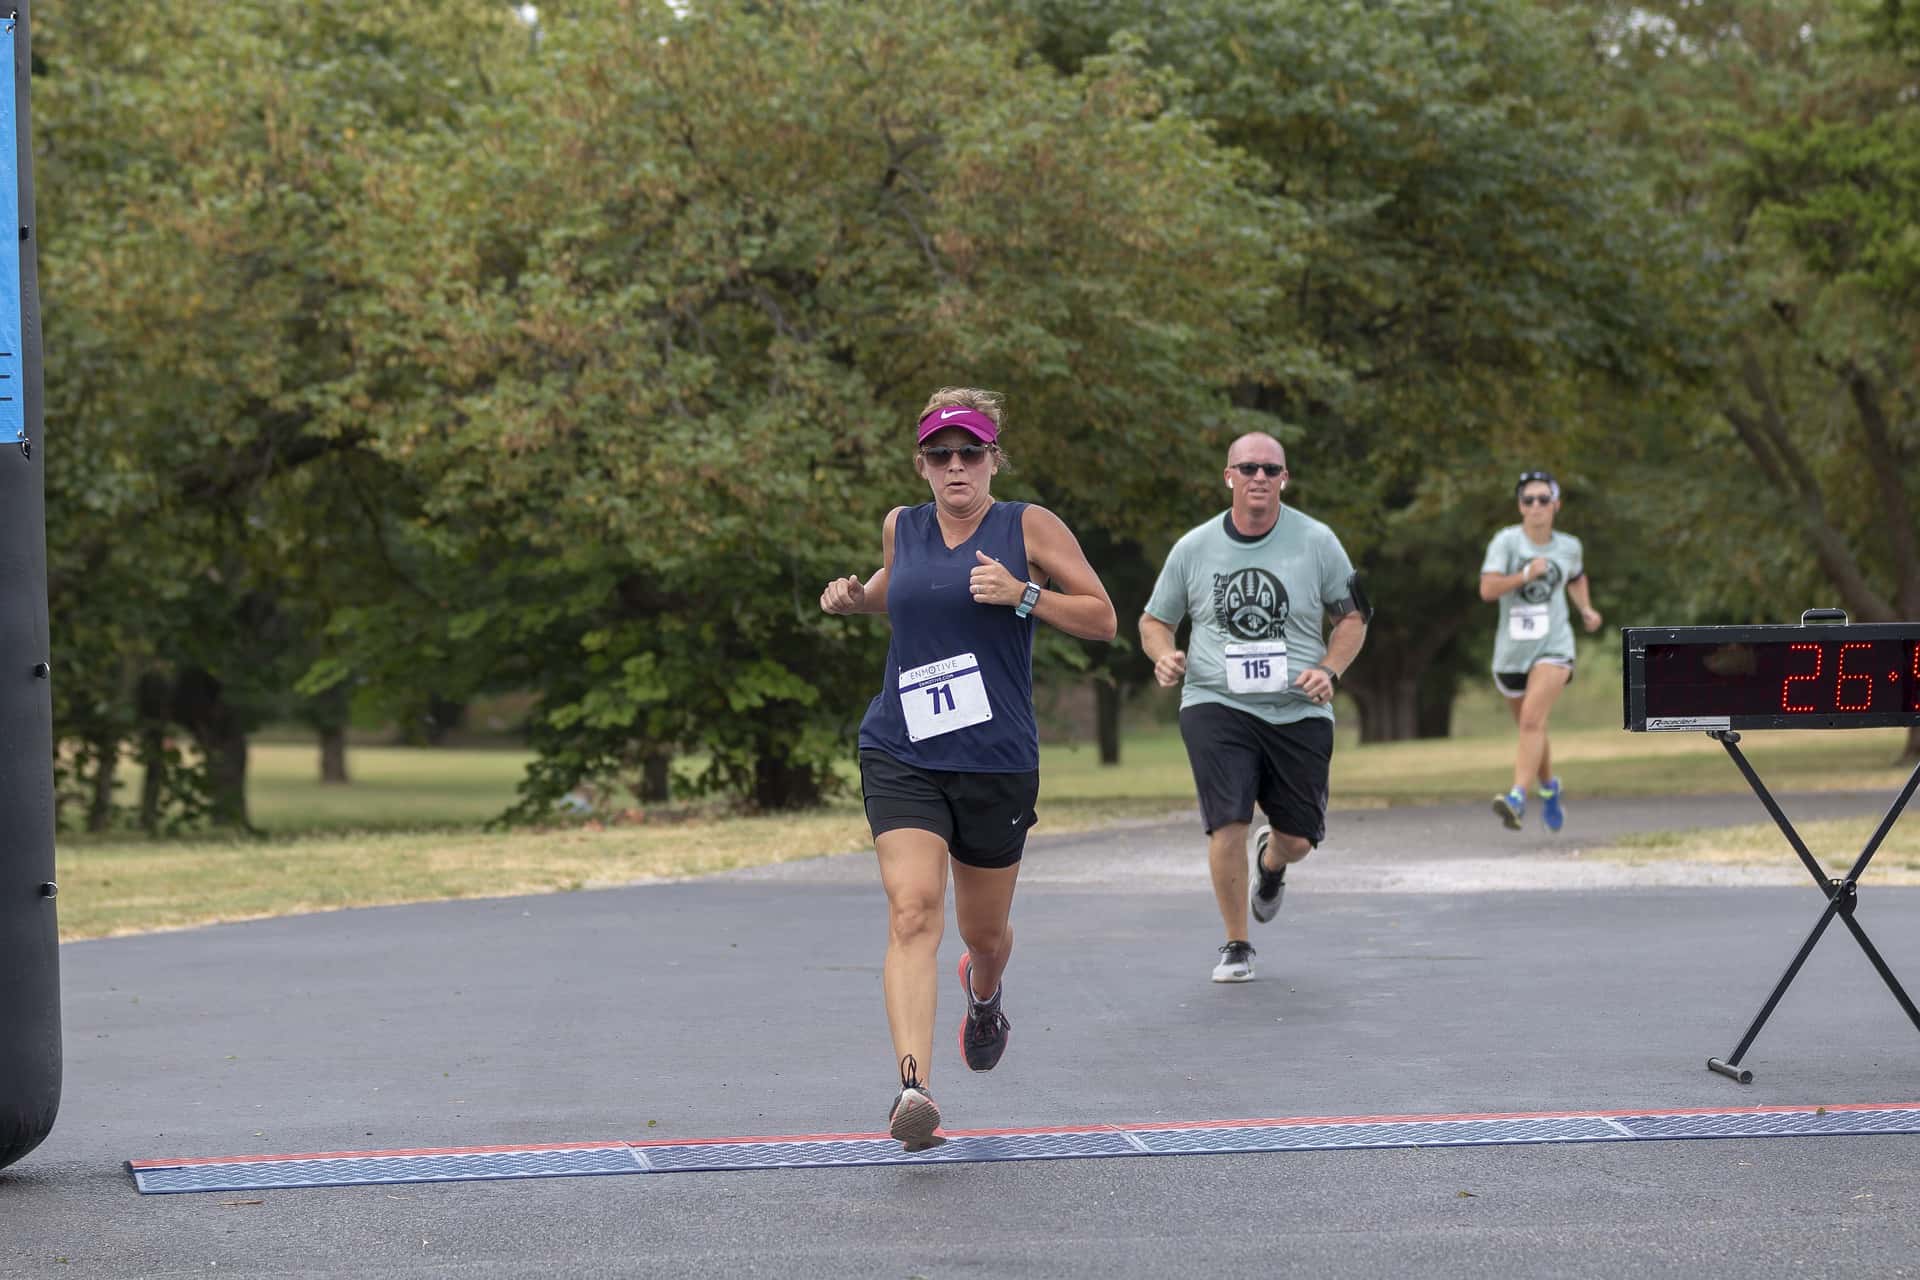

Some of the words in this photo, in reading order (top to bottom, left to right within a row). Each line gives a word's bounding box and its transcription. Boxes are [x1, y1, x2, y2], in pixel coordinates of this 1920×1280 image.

[910, 660, 958, 680] ENMOTIVE
[1242, 660, 1271, 680] 115
[926, 683, 956, 715] 71
